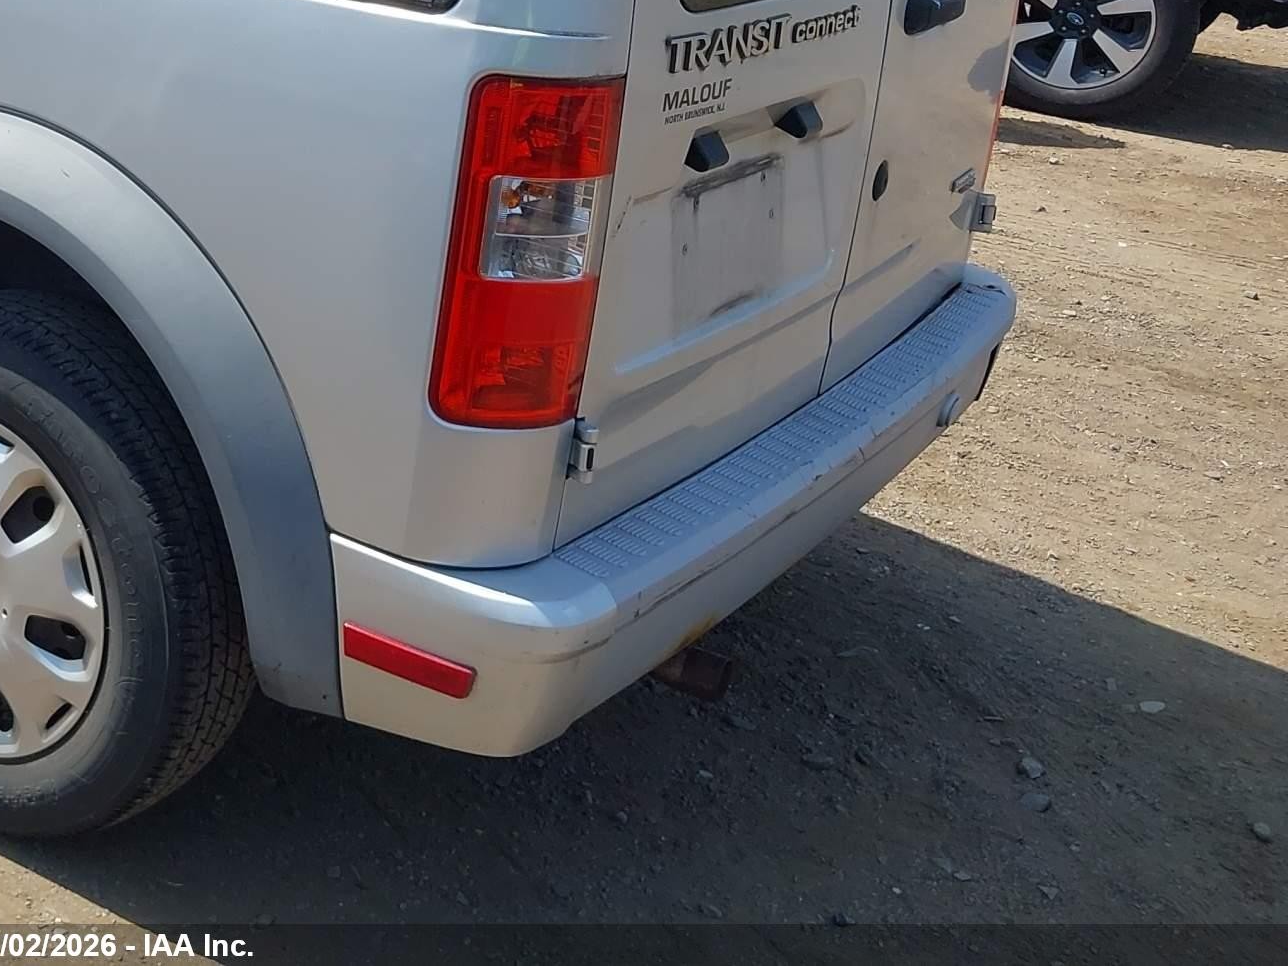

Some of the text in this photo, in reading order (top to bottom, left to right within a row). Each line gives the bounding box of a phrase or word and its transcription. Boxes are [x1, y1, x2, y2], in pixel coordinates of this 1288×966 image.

[666, 5, 860, 73] TRANSIT connect
[663, 78, 732, 112] MALOUF
